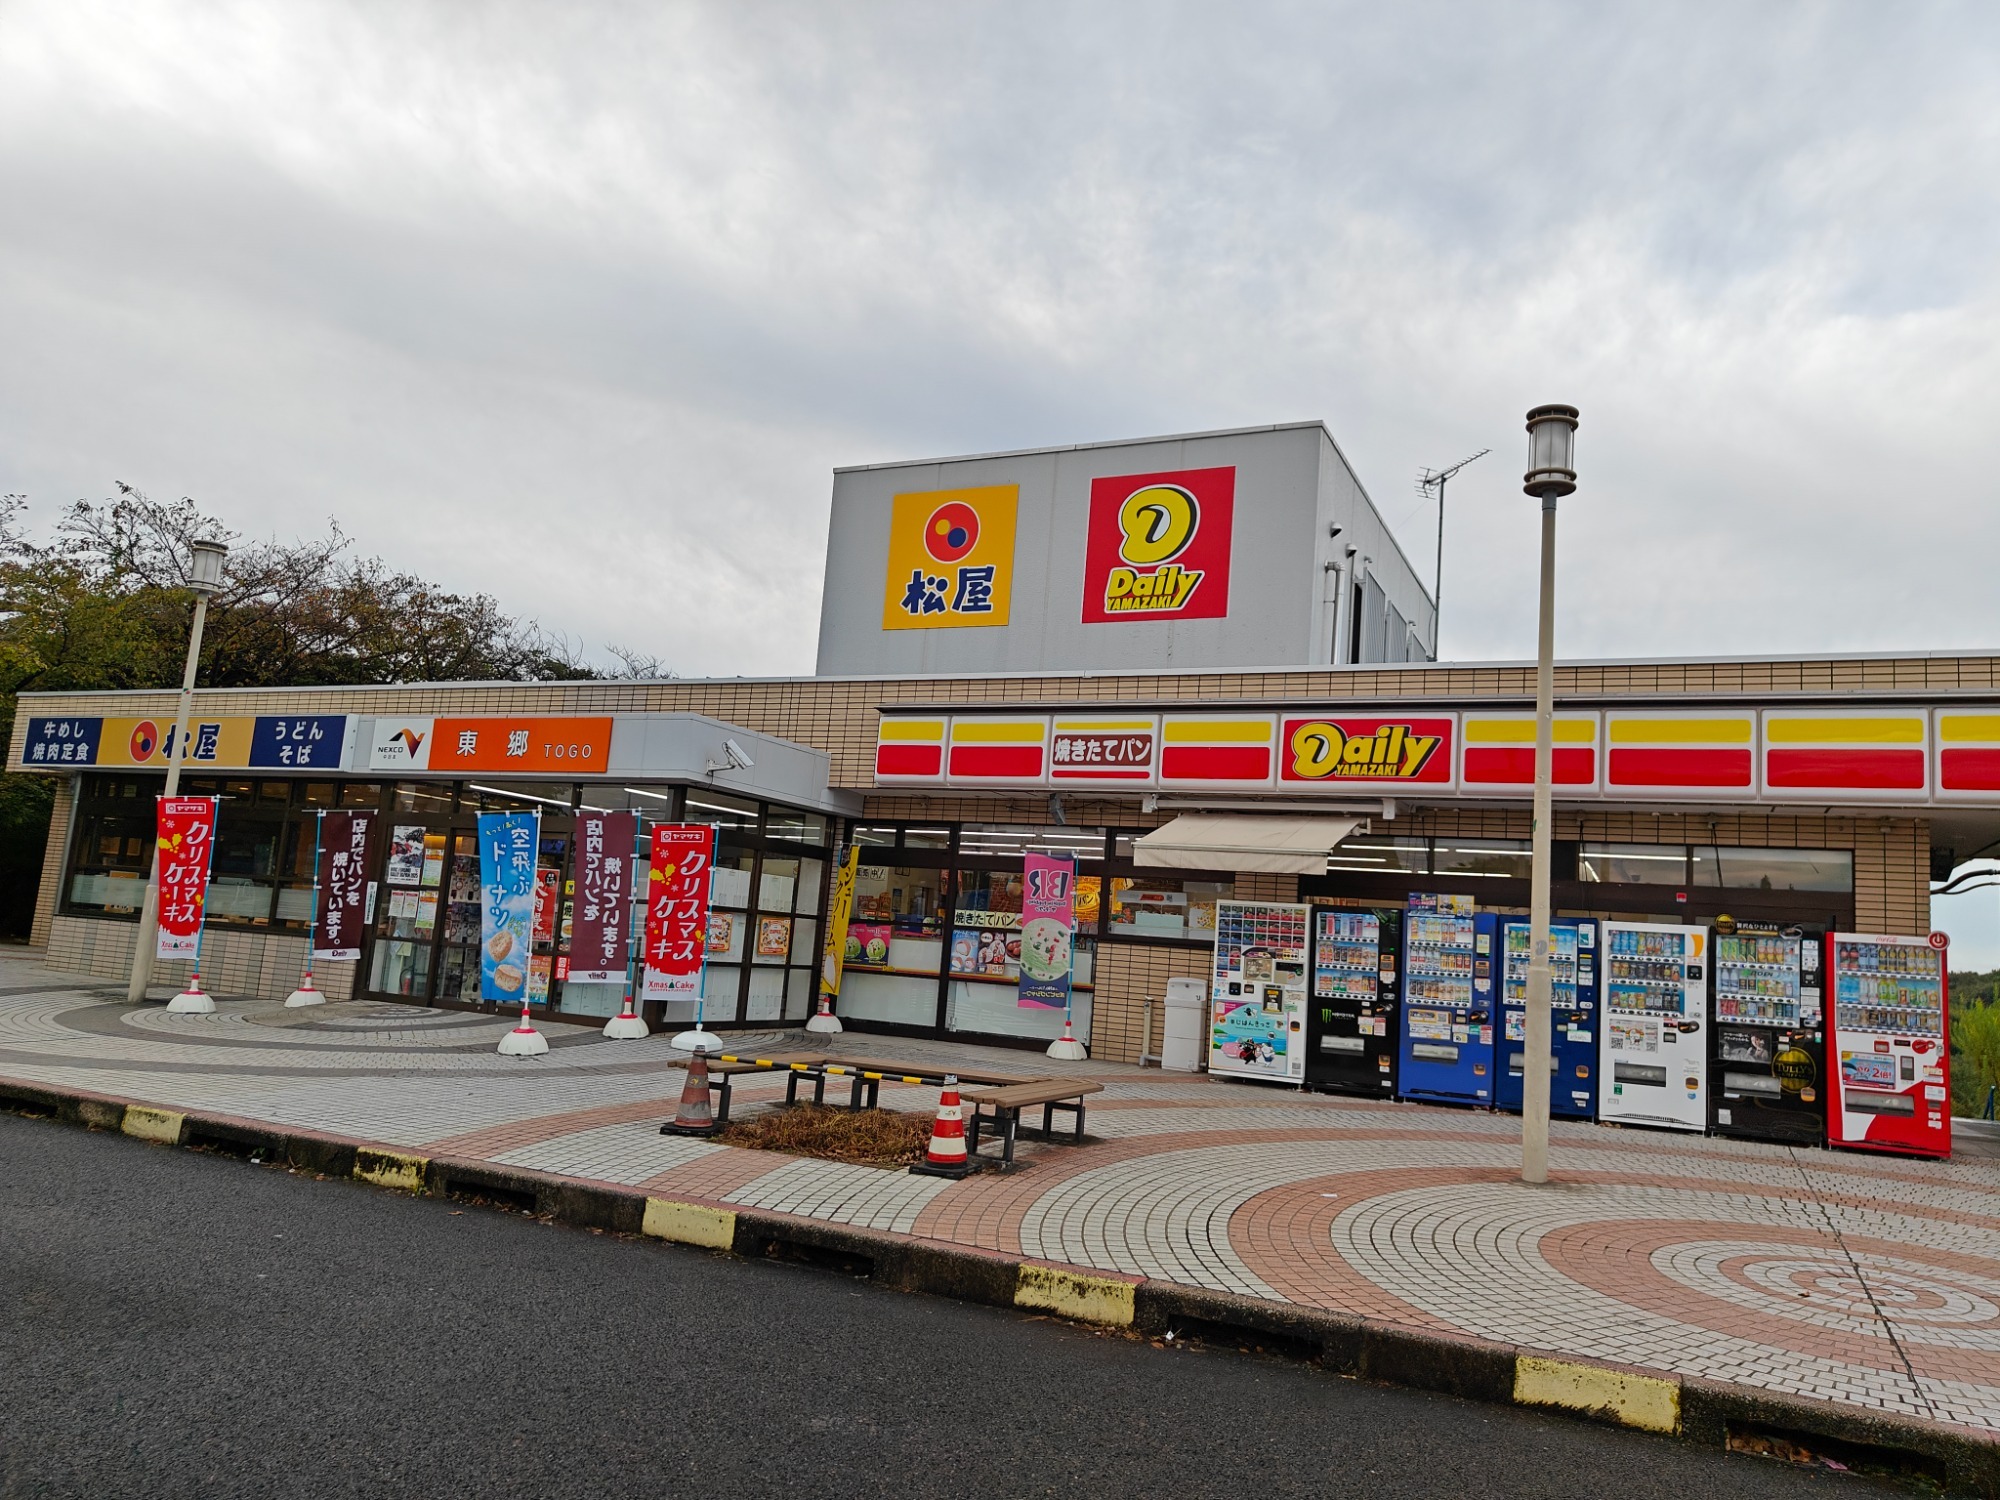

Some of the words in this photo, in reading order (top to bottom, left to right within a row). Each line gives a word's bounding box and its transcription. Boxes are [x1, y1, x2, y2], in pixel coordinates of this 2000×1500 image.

[901, 566, 995, 615] 松屋
[1107, 597, 1173, 611] YAMAZAKI
[1108, 565, 1204, 608] Daily
[32, 743, 90, 761] 焼肉定食
[44, 721, 84, 738] 牛めし
[275, 722, 323, 740] うどん
[457, 730, 529, 757] 東郷
[544, 744, 592, 758] TOGO
[1055, 737, 1151, 763] 焼きたてパン
[1292, 722, 1442, 778] Daily
[279, 745, 311, 764] そば
[1336, 764, 1398, 776] YAMAZAKI
[177, 821, 209, 923] クリスマス
[346, 818, 367, 906] 店内でパンを
[491, 841, 510, 928] ドーナツ
[511, 827, 531, 896] 空飛ぶ
[164, 862, 187, 922] ケーキ
[326, 851, 349, 946] 焼いています。
[673, 850, 706, 961] クリスマス
[828, 880, 843, 947] クリーム
[842, 866, 854, 920] シュー
[651, 895, 680, 960] ケーキ
[955, 911, 1015, 926] 焼きたてパン
[648, 980, 668, 989] Xmas
[675, 980, 695, 989] Cake
